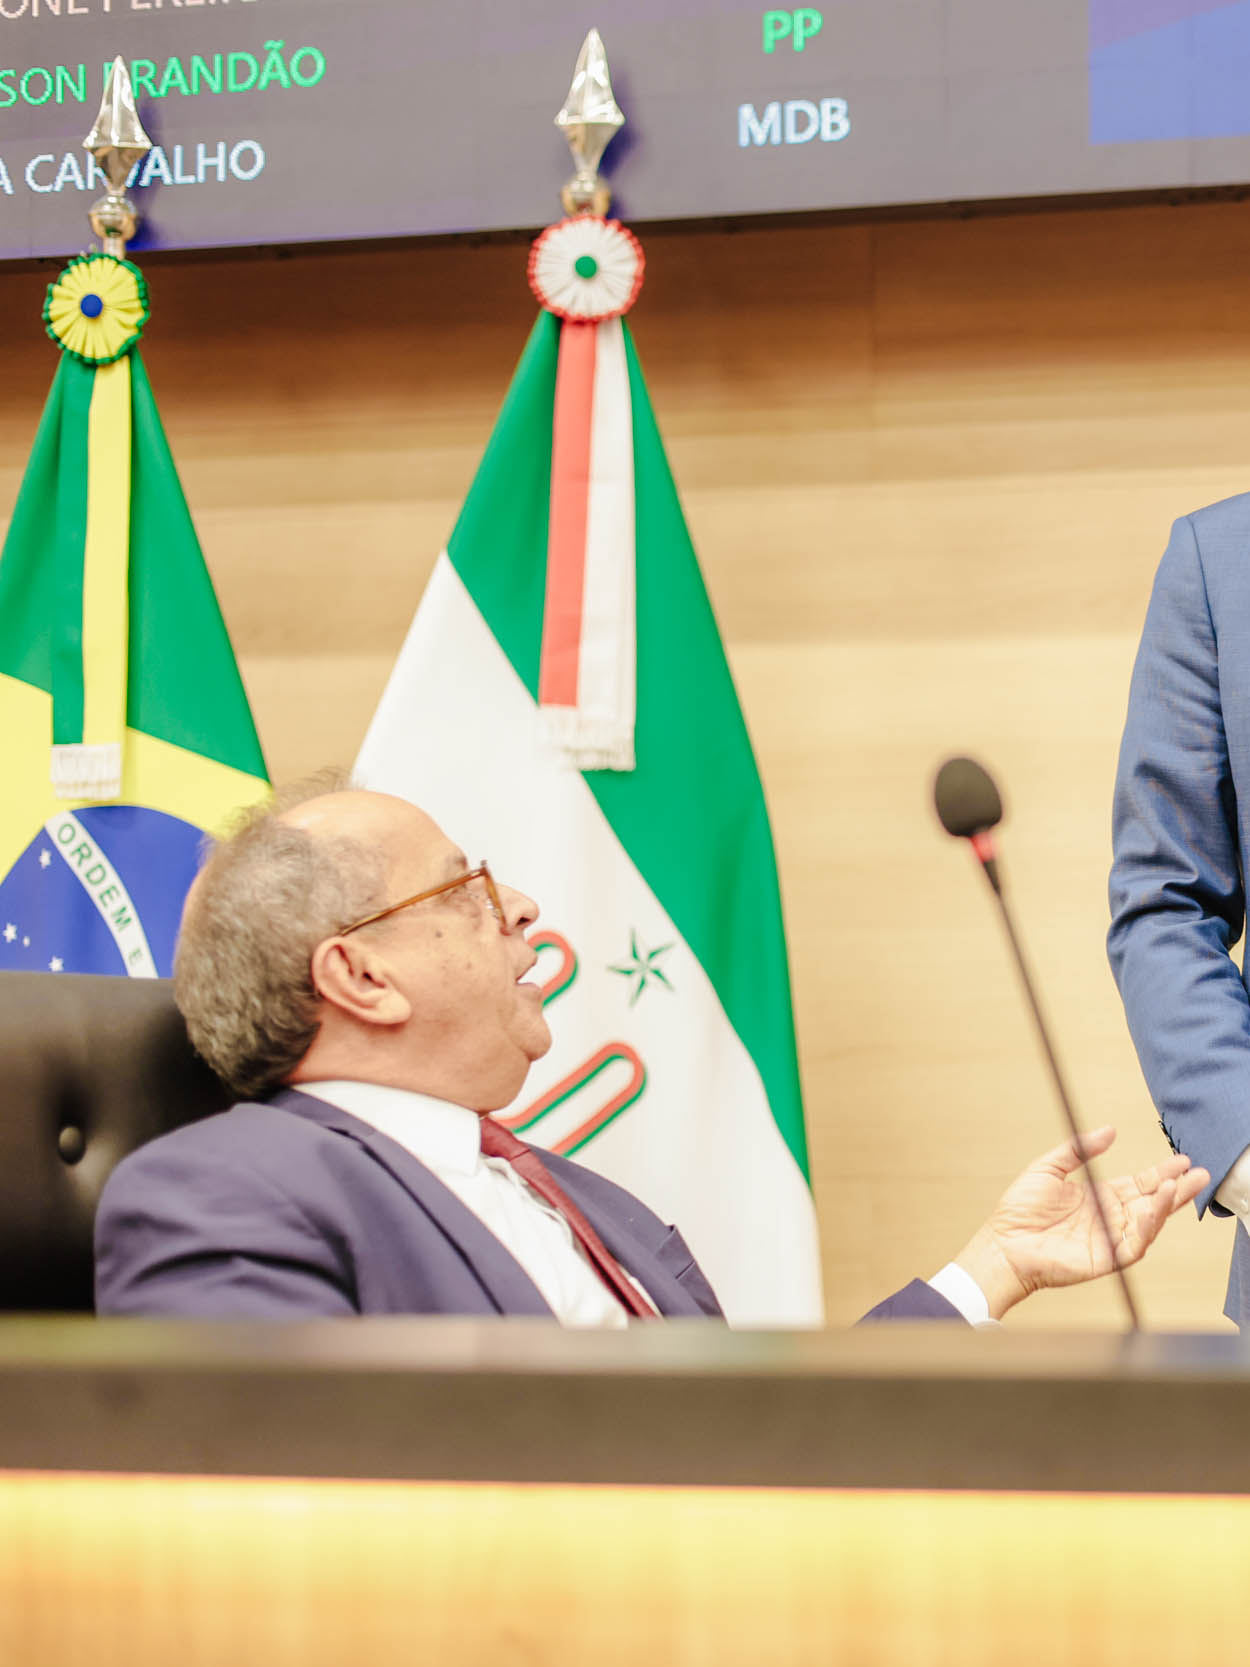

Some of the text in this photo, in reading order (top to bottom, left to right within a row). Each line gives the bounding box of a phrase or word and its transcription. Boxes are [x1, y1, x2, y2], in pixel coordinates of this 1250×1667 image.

[763, 8, 824, 54] PP
[0, 39, 327, 108] SON RANDÃO
[738, 97, 851, 147] MDB
[57, 823, 133, 933] ORDEM
